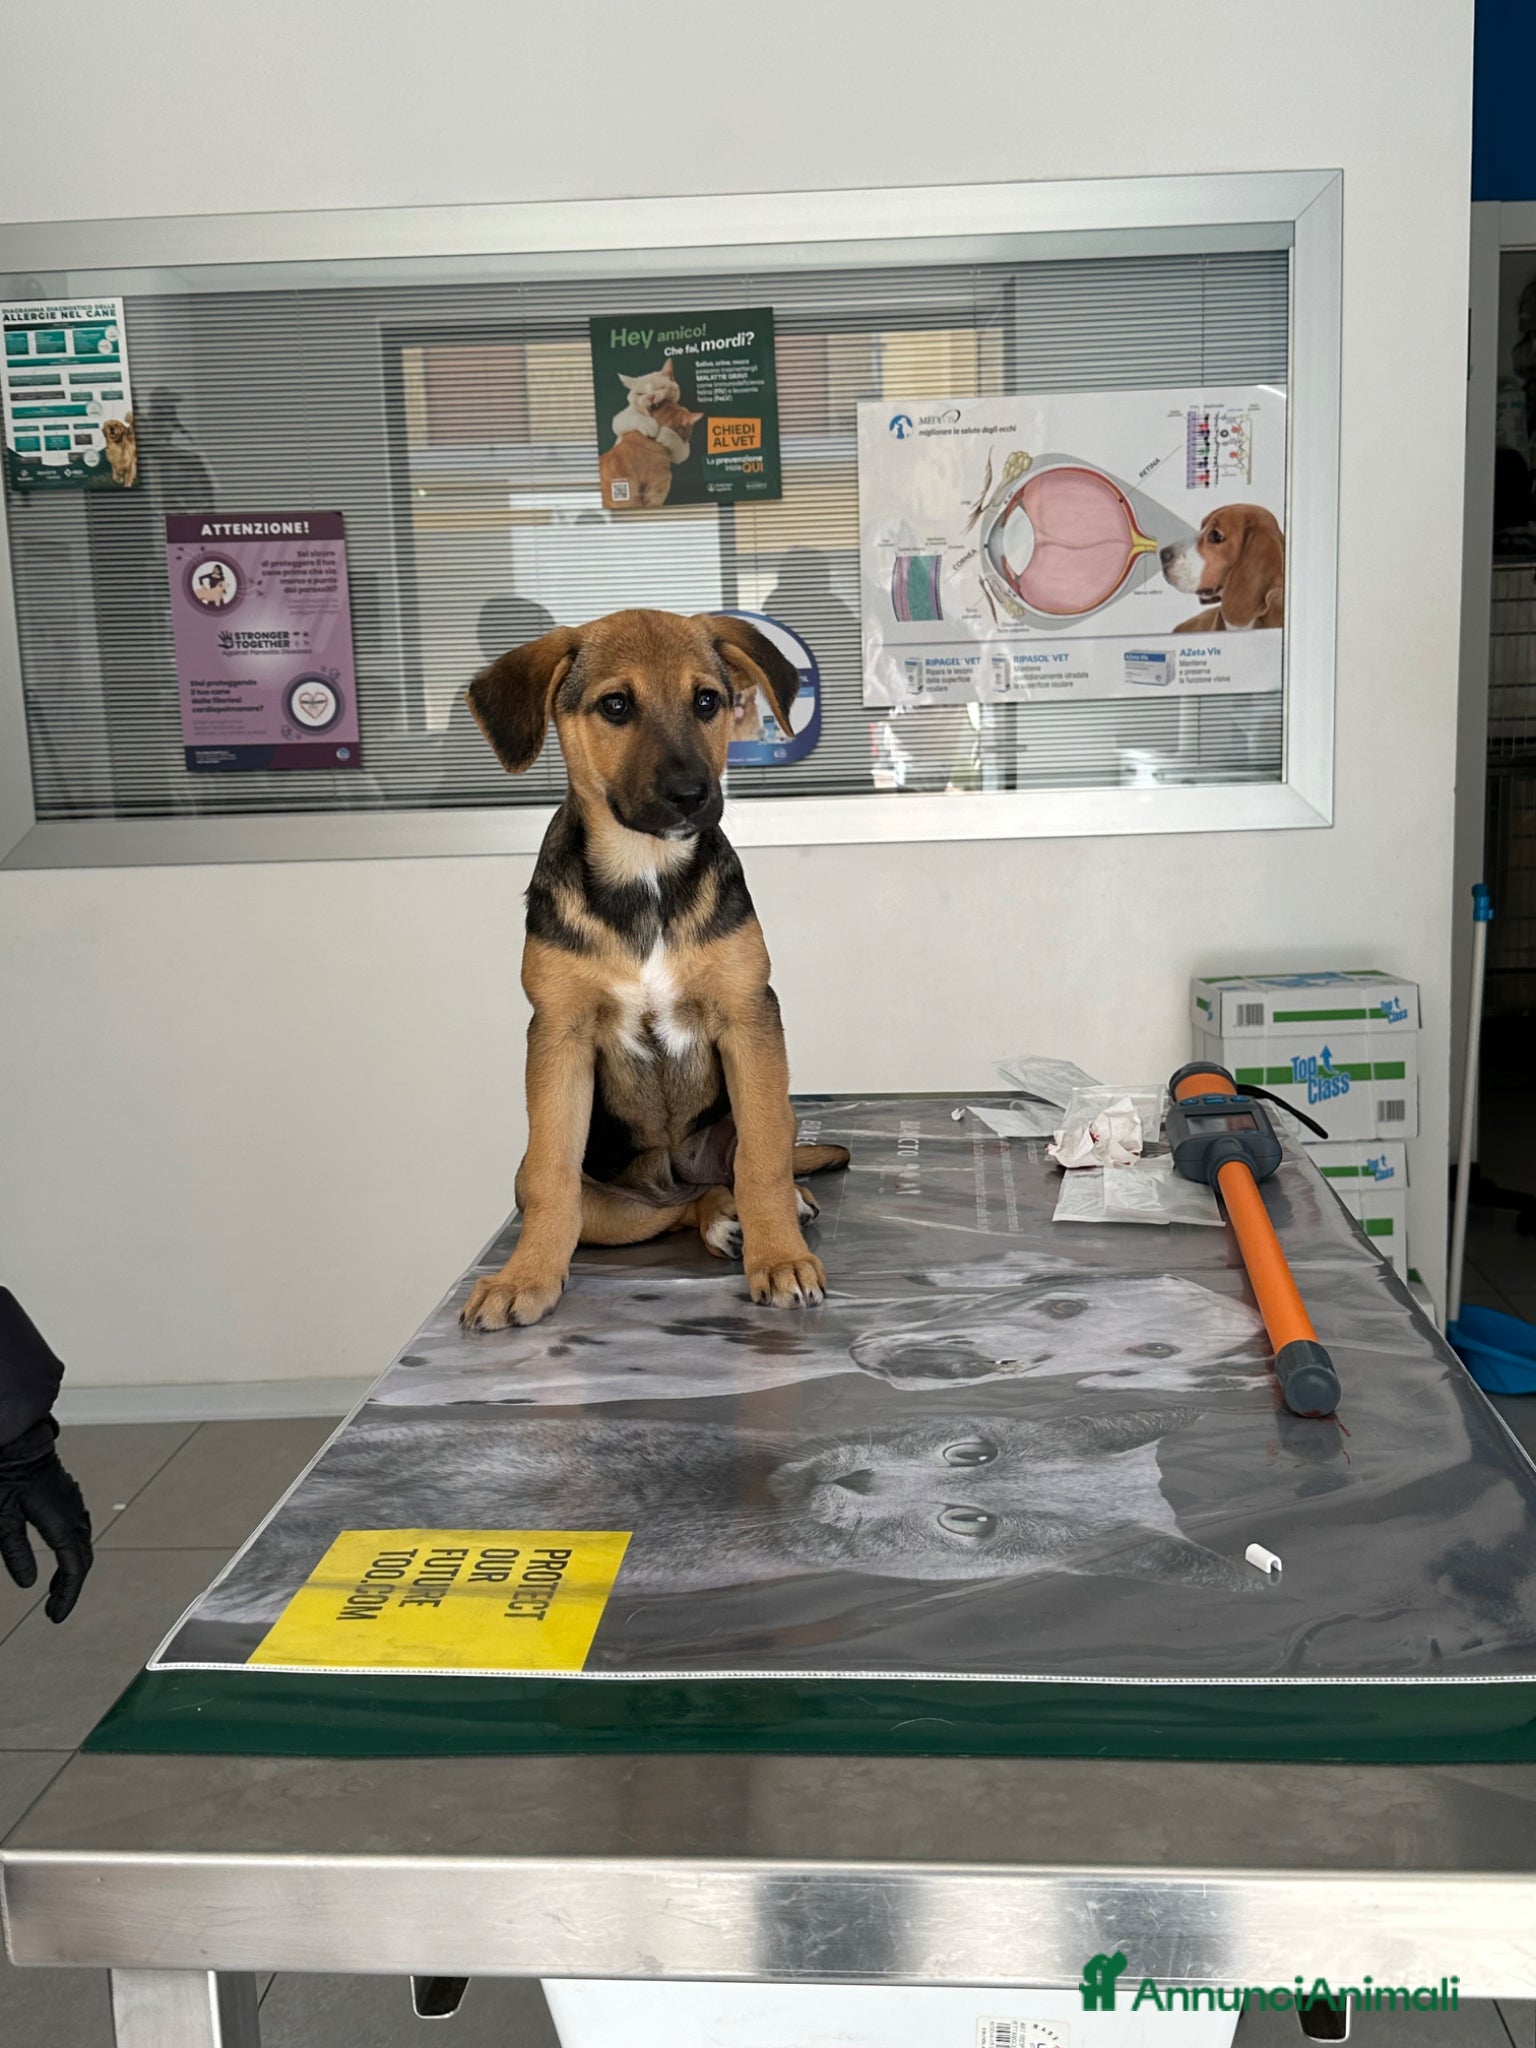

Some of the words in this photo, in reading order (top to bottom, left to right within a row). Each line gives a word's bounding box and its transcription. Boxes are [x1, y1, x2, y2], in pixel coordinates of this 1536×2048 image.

[3, 312, 57, 321] ALLERGIE
[61, 310, 82, 319] NEL
[86, 309, 117, 318] CANE
[610, 328, 653, 349] Hey
[657, 323, 707, 342] amico!
[664, 346, 684, 357] Che
[685, 344, 700, 355] fai,
[701, 331, 755, 351] mordi?
[712, 424, 755, 436] CHIEDI
[713, 437, 729, 447] AL
[731, 436, 755, 446] VET
[716, 454, 763, 466] prevenzione
[743, 462, 764, 473] QUI
[1138, 458, 1160, 479] RETINA
[201, 521, 309, 536] ATTENZIONE!
[952, 548, 977, 571] CORNEA
[235, 632, 289, 640] STRONGER
[236, 640, 289, 648] TOGETHER
[1180, 648, 1206, 656] AZeta
[1207, 647, 1221, 655] Vis
[925, 657, 961, 666] RIPAGEL
[964, 656, 981, 665] VET
[1014, 654, 1049, 663] RIPASOL
[1051, 653, 1069, 662] VET
[1380, 999, 1393, 1015] Top
[1388, 1008, 1407, 1024] Class
[1291, 1055, 1317, 1082] Top
[1307, 1072, 1350, 1105] Class
[1367, 1158, 1378, 1173] Top
[1374, 1167, 1394, 1182] Class
[467, 1548, 520, 1583] OUR
[336, 1548, 418, 1621] TOO.COM
[398, 1548, 469, 1608] FUTURE
[504, 1549, 572, 1621] PROTECT
